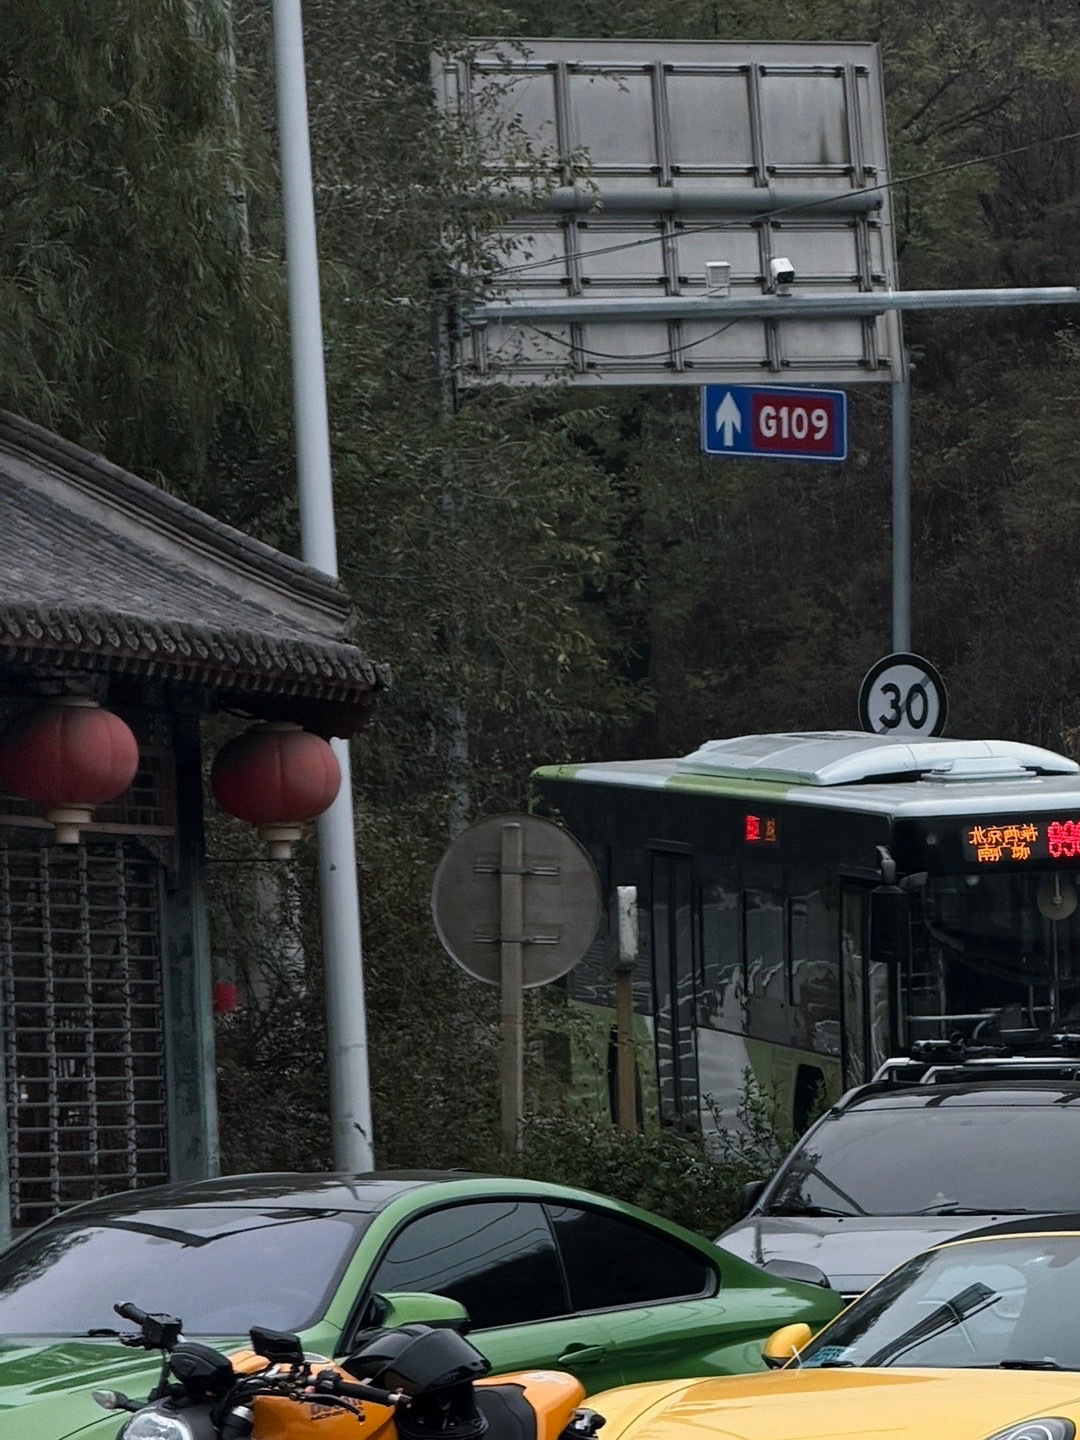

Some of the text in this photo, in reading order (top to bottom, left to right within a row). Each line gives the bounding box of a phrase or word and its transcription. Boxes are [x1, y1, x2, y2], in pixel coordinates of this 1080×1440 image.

[759, 405, 828, 440] G109
[879, 683, 928, 729] 30
[968, 823, 1038, 845] 北京西站
[978, 841, 1031, 862] 南广场
